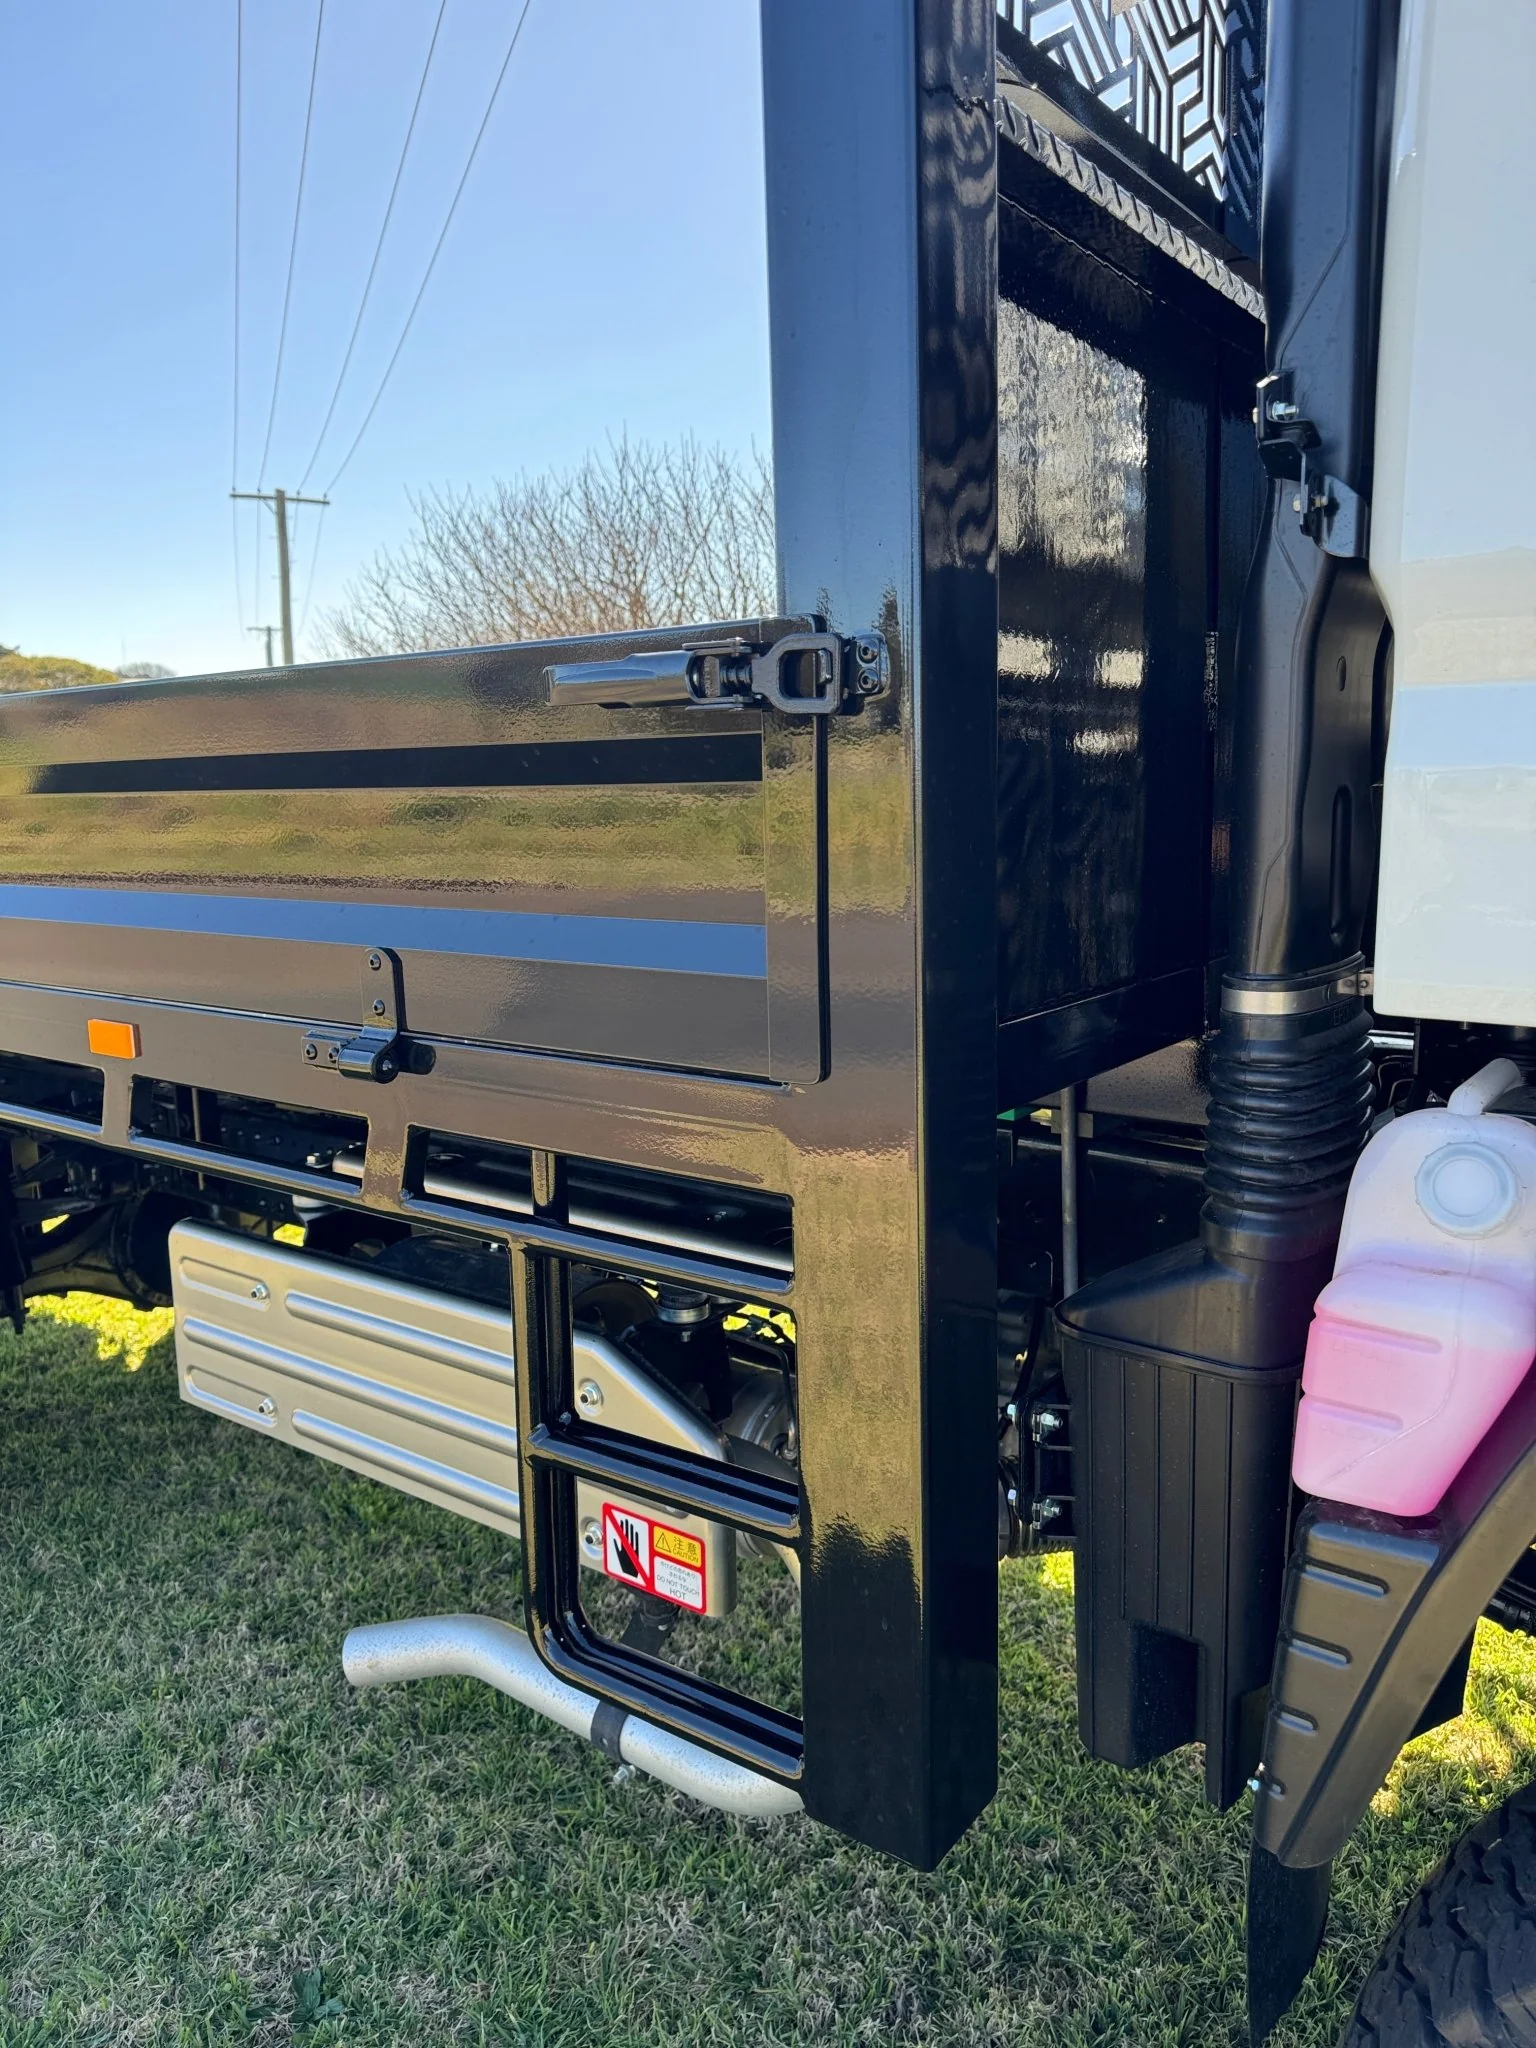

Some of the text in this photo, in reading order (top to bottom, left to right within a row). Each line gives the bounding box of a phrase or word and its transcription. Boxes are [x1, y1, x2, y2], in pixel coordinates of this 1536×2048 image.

[674, 1536, 697, 1555] 注意
[672, 1548, 699, 1563] CAUTION
[656, 1574, 700, 1597] DO NOT TOUCH
[669, 1587, 686, 1599] HOT
